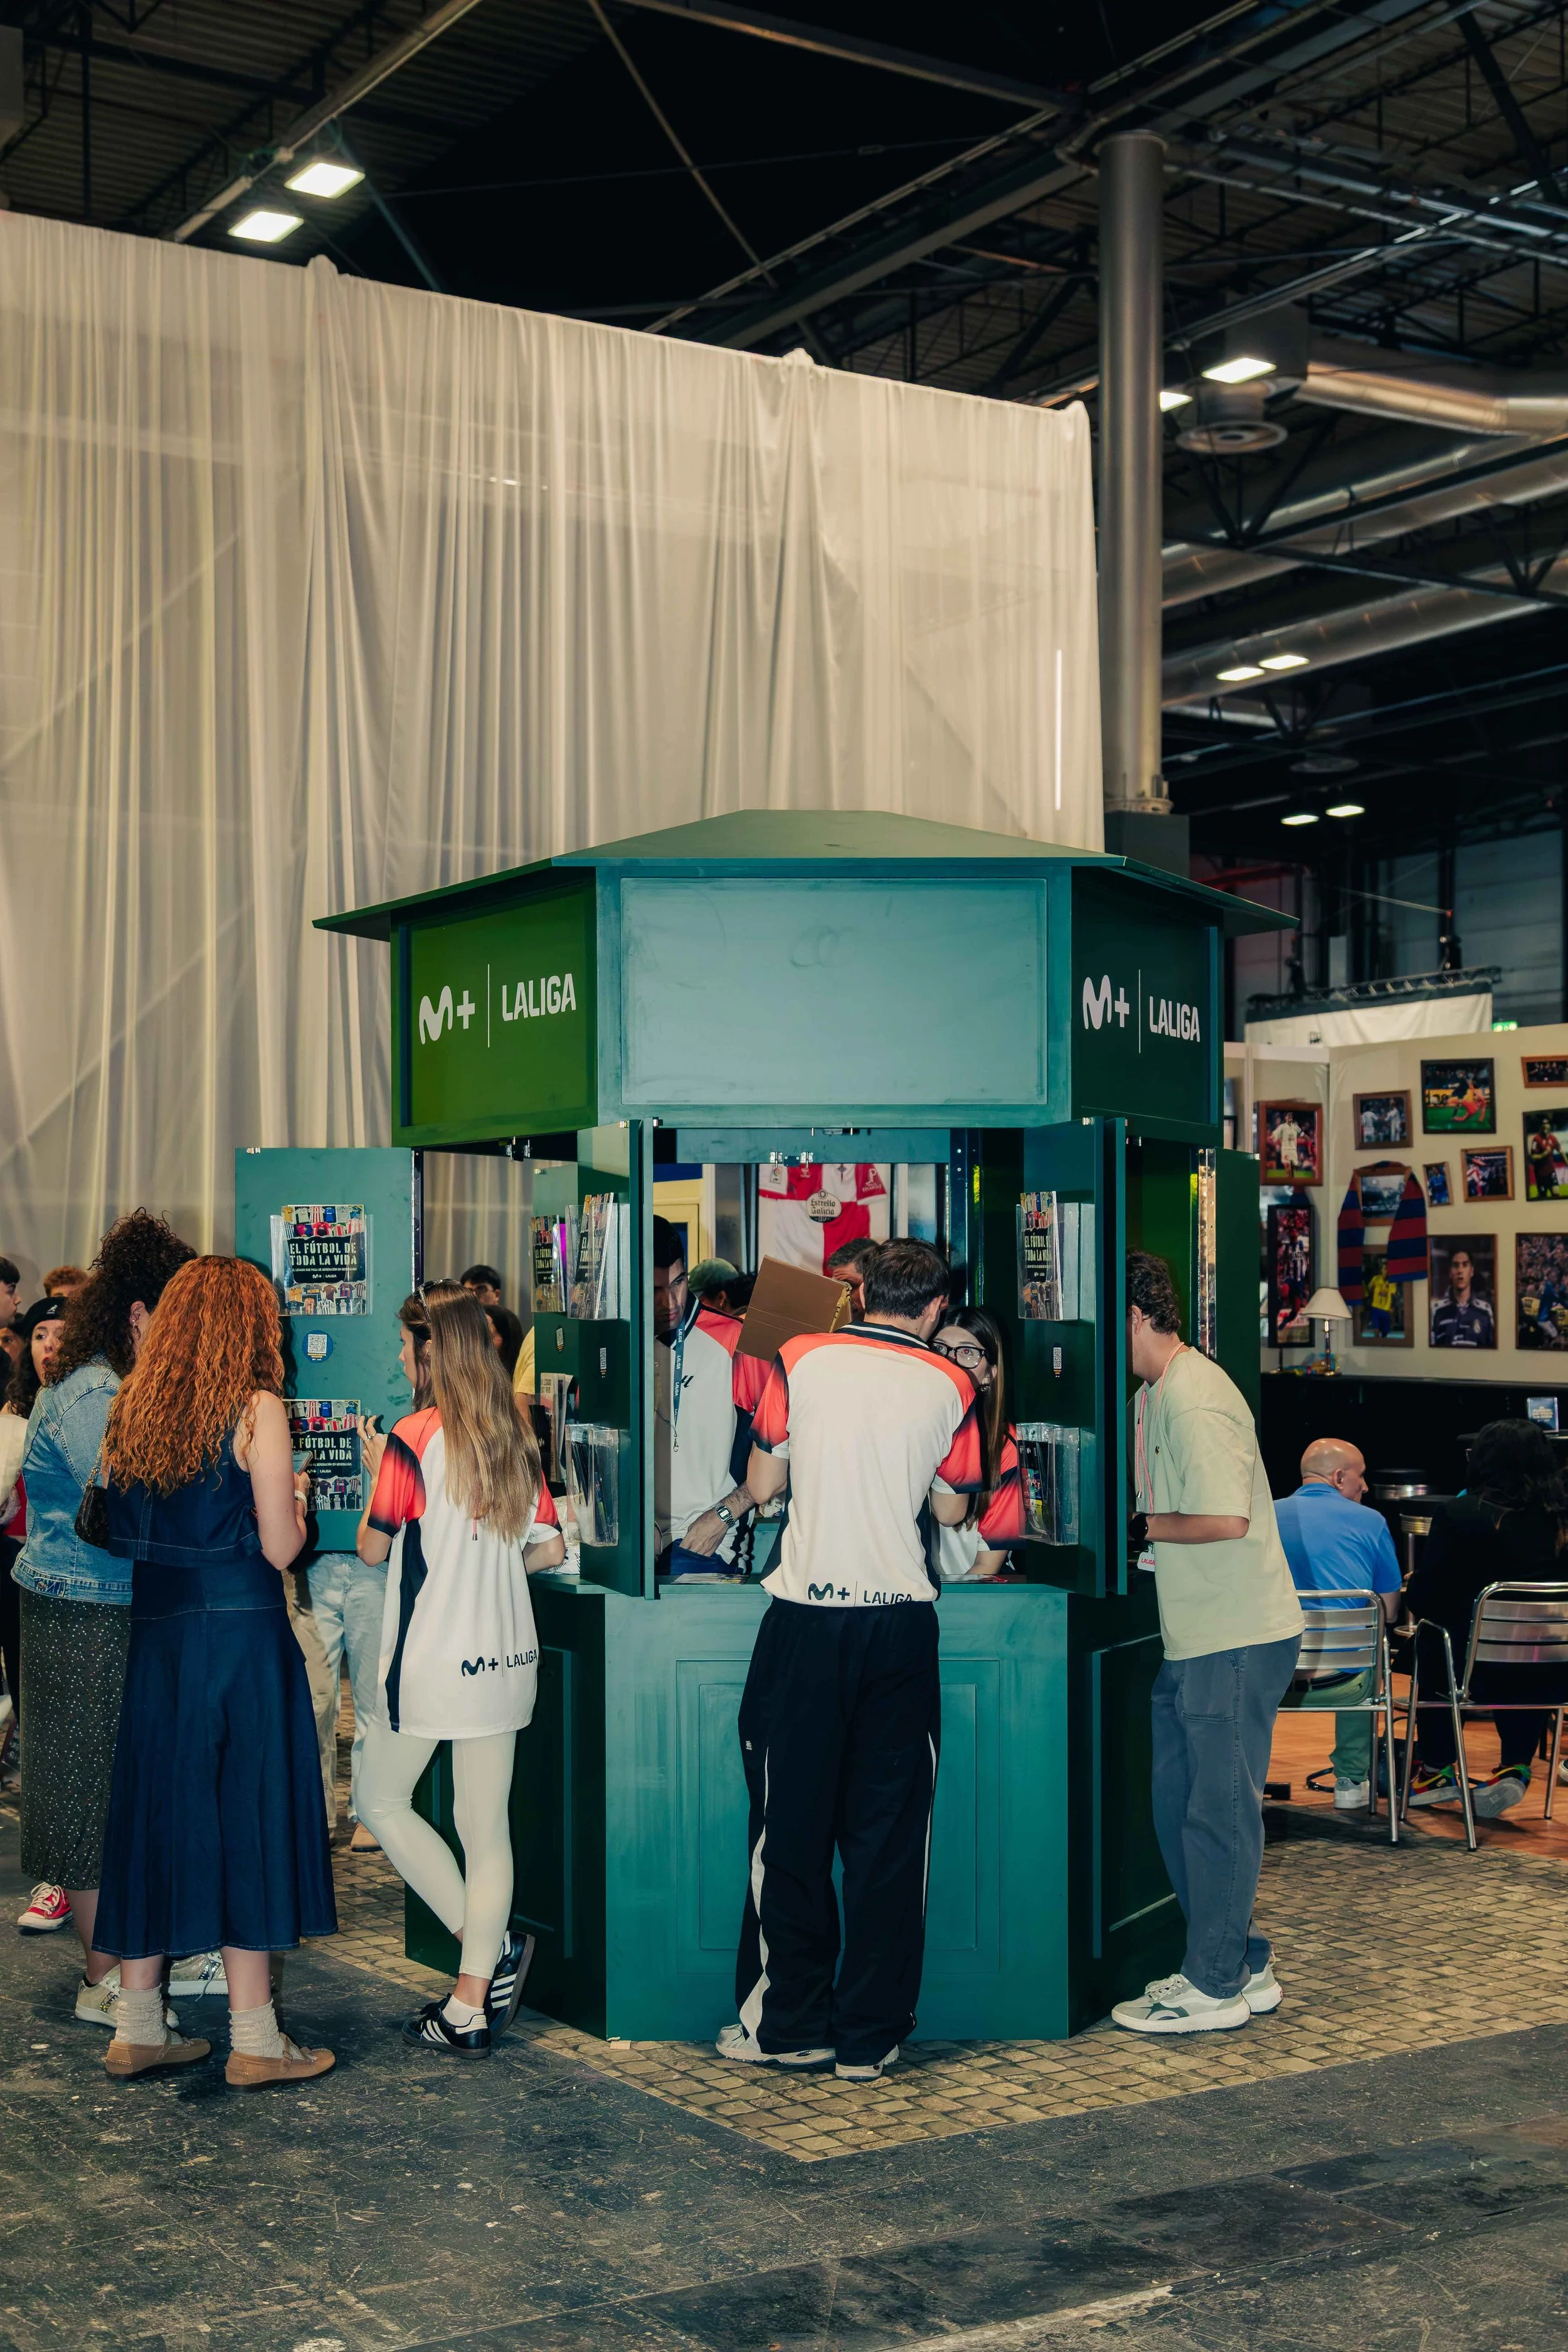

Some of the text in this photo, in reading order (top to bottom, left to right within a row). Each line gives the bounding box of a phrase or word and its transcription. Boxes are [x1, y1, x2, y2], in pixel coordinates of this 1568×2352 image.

[502, 973, 576, 1022] LALIGA
[1150, 995, 1200, 1042] LALIGA
[811, 1199, 836, 1207] Estrella
[811, 1205, 835, 1215] Galicia
[290, 1240, 356, 1254] EL FÚTBOL DE
[1025, 1236, 1030, 1248] EL
[290, 1254, 357, 1266] TODA LA VIDA
[1025, 1249, 1036, 1261] TODA
[1036, 1249, 1042, 1261] LA
[299, 1435, 336, 1448] FÚTBOL
[339, 1438, 352, 1448] DE
[314, 1449, 352, 1460] LA VIDA
[864, 1590, 913, 1604] LALIGA
[506, 1648, 538, 1668] LALIGA
